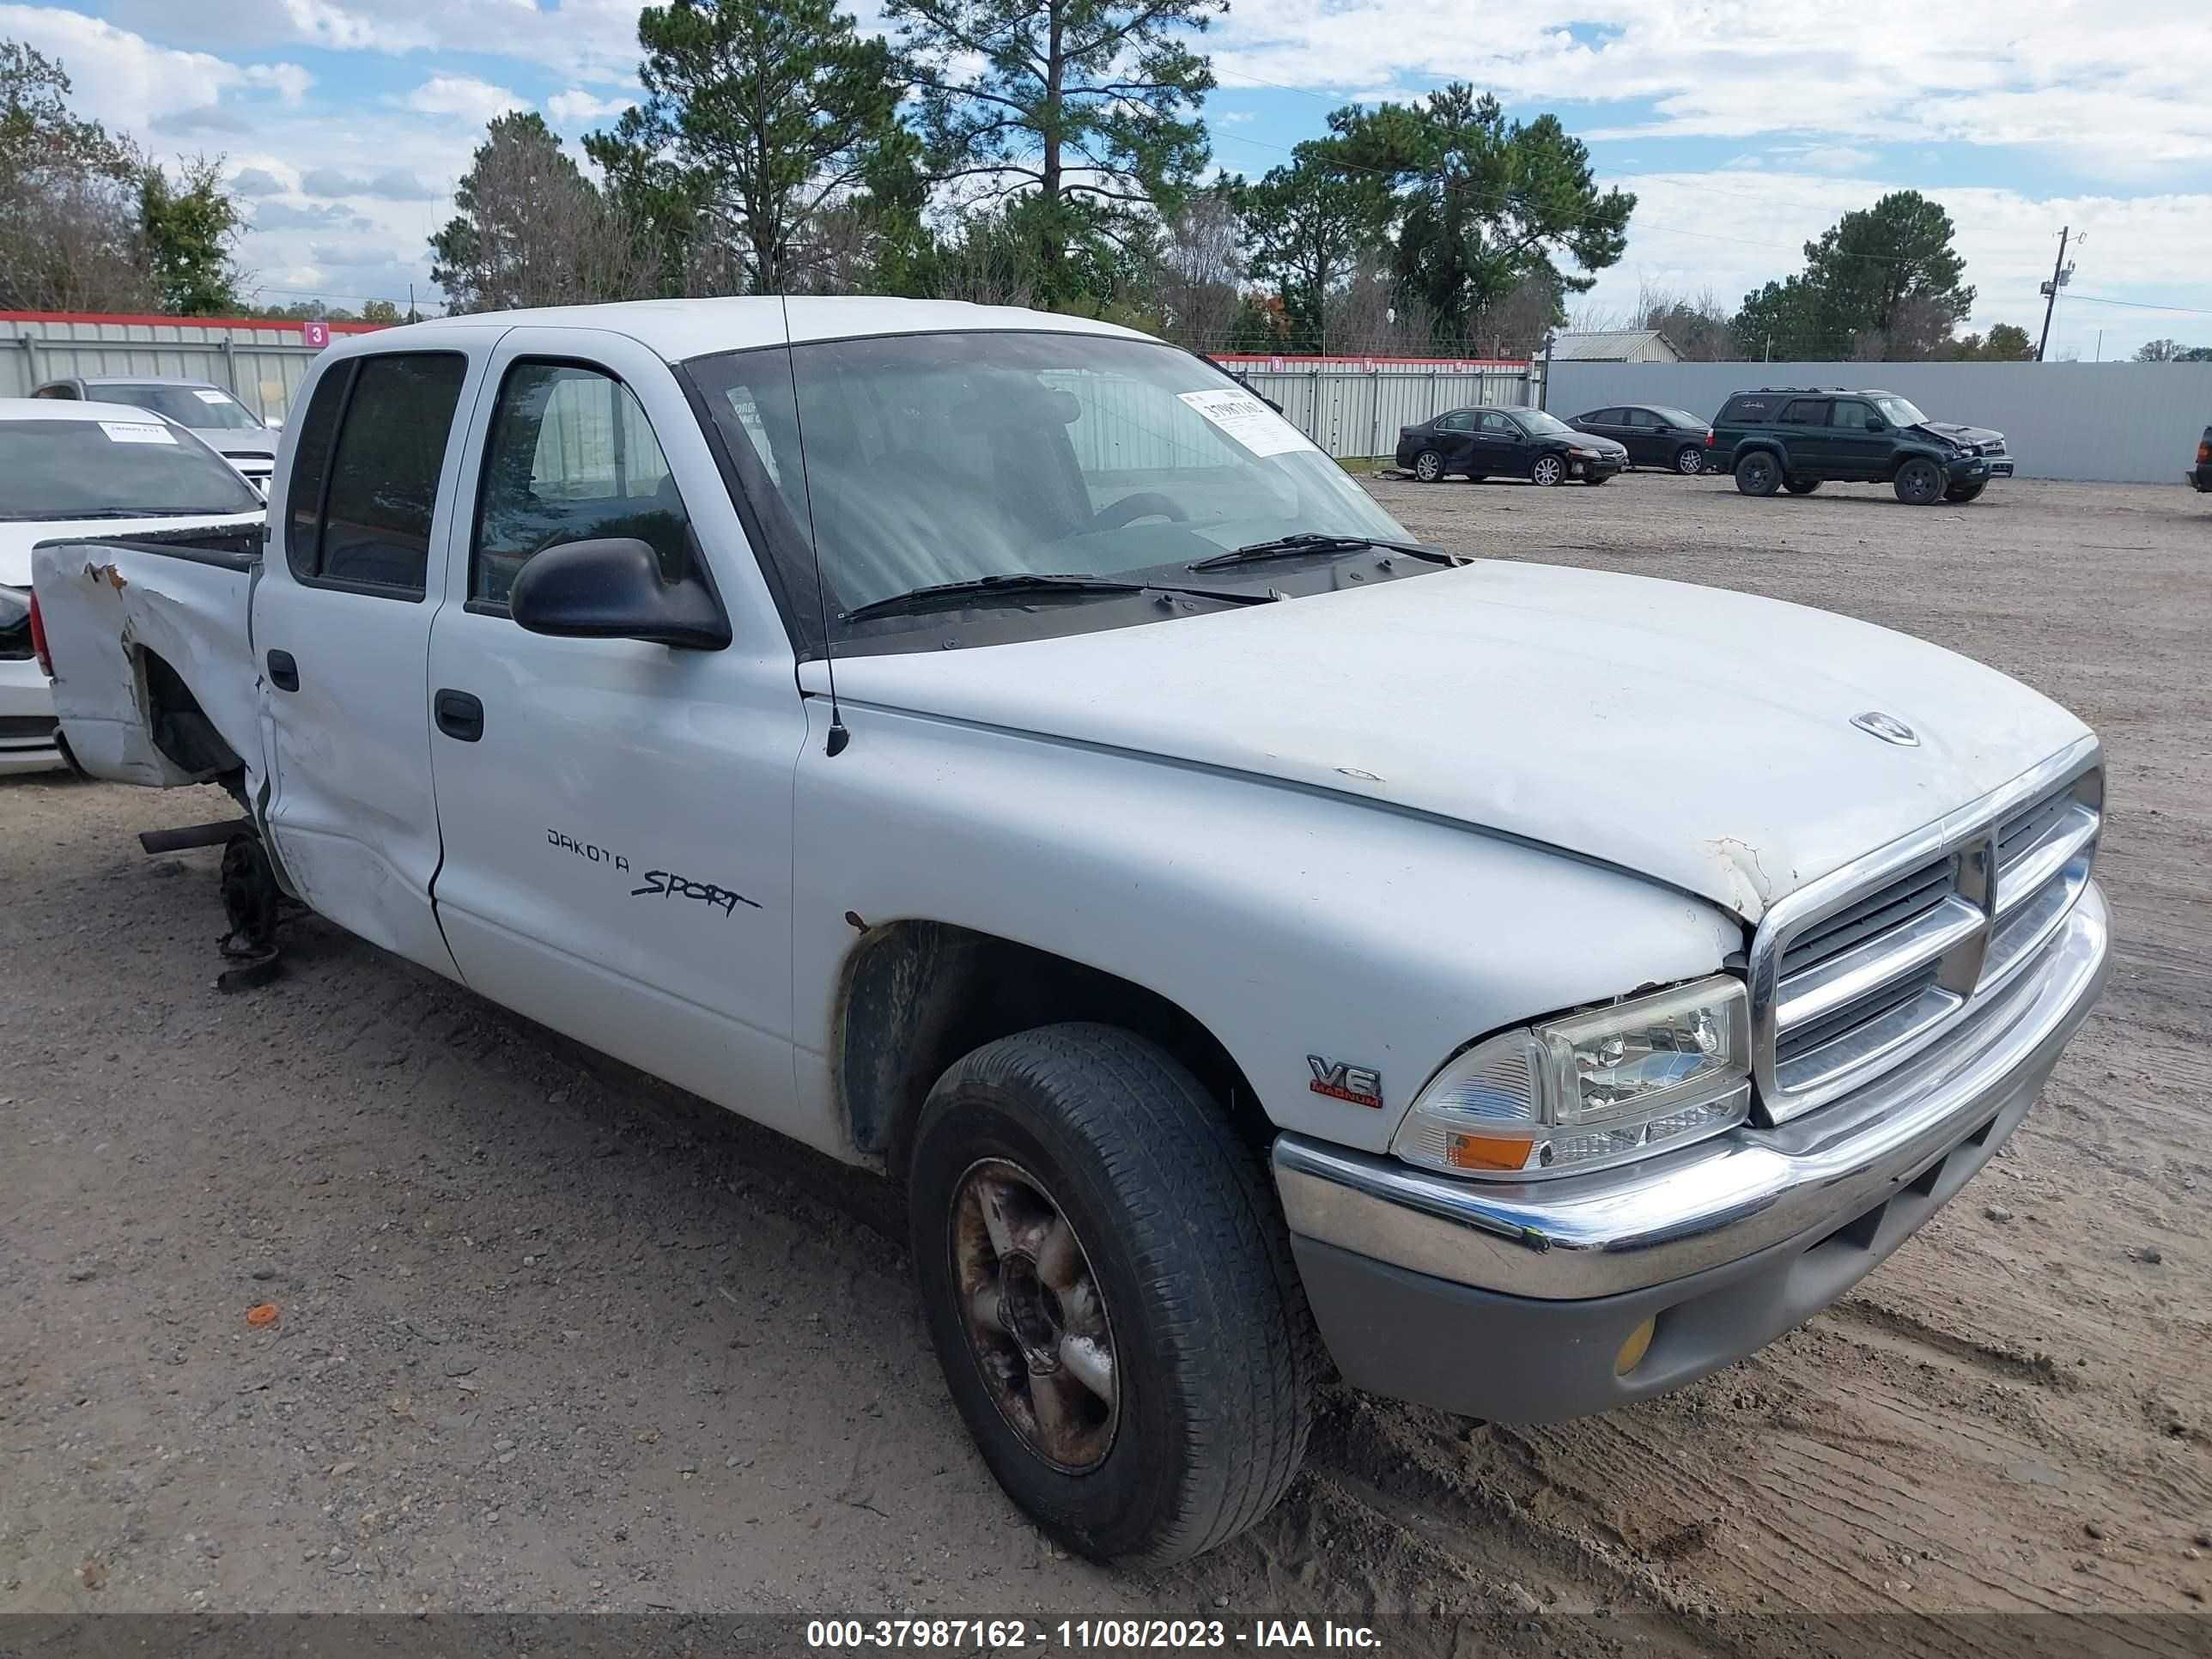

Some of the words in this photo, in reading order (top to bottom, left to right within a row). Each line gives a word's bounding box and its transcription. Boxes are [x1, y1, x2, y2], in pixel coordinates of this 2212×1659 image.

[313, 326, 322, 343] 3
[547, 828, 630, 873] DAKOTA
[631, 869, 763, 919] SPORT
[1306, 1054, 1381, 1096] V6
